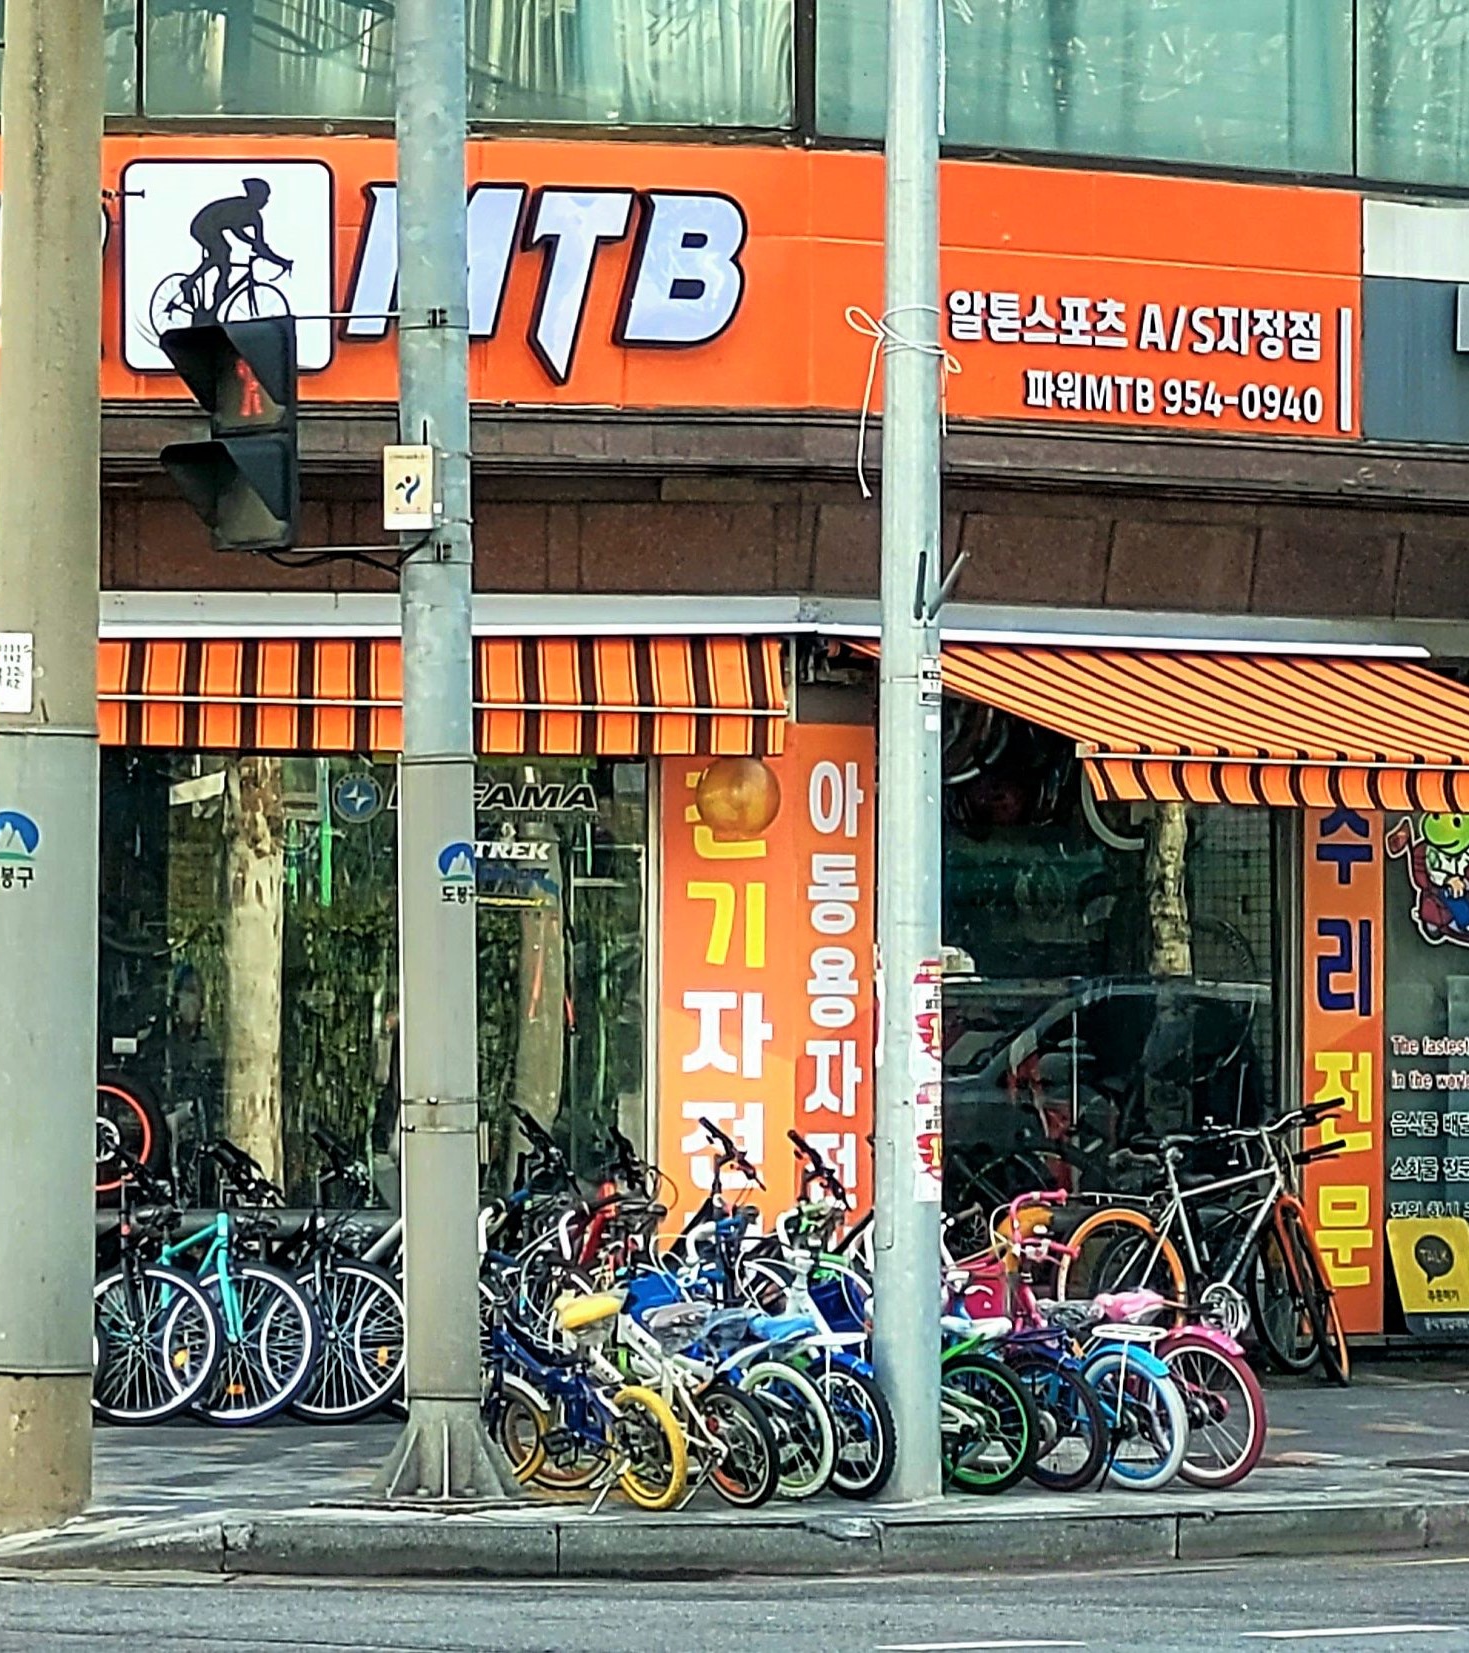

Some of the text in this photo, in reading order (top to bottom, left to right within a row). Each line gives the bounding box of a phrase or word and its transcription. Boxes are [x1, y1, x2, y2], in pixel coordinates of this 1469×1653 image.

[340, 181, 747, 387] MTB
[947, 288, 1323, 362] 알톤스포츠 A/S지정점
[1025, 368, 1324, 424] 파워MTB 954-0940
[473, 841, 552, 861] TREK
[680, 771, 774, 1245] 기자전
[804, 760, 865, 1248] 아동용자전
[1391, 1035, 1419, 1056] The
[1409, 1069, 1432, 1089] the
[1390, 1111, 1439, 1137] 음식물
[1390, 1156, 1439, 1182] 소화물
